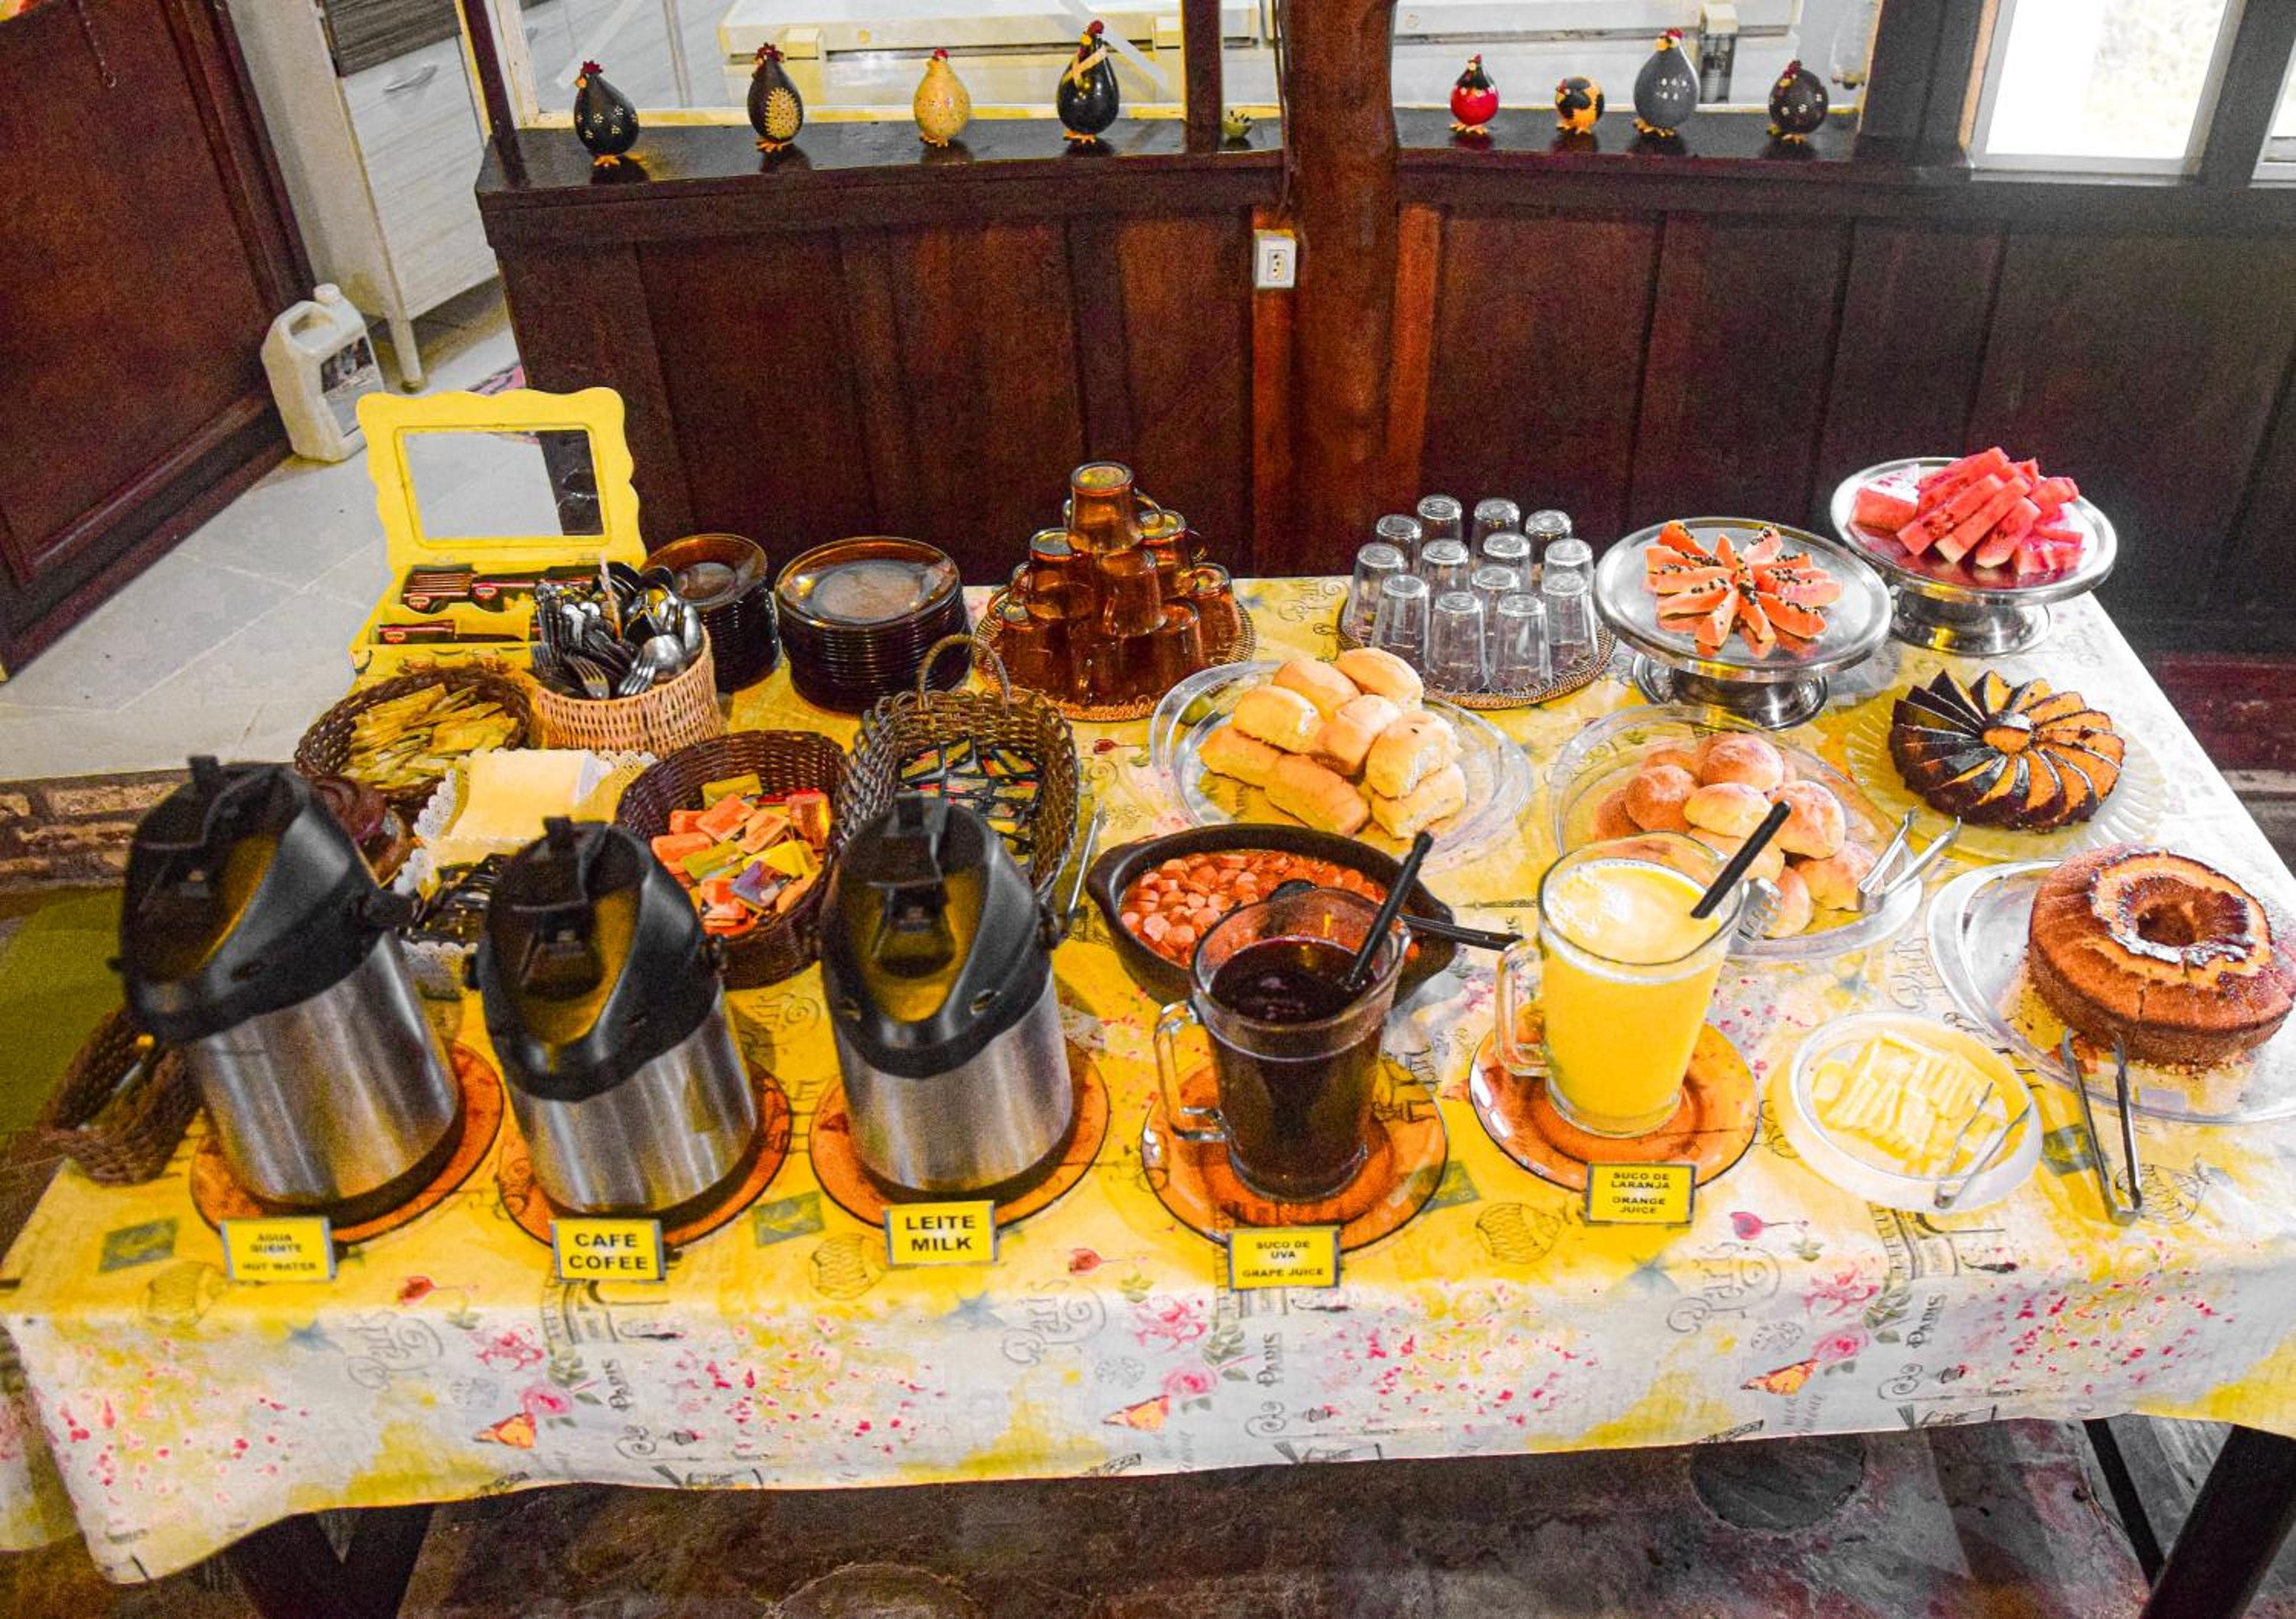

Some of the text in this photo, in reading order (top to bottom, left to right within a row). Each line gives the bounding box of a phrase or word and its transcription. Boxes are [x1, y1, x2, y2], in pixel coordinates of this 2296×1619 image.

[1613, 1171, 1670, 1181] SUCO DE
[1613, 1197, 1665, 1205] ORANGE
[1619, 1206, 1656, 1214] JUICE
[905, 1215, 976, 1230] LEITE
[912, 1237, 973, 1252] MILK
[1270, 1250, 1296, 1259] UVA
[569, 1255, 648, 1270] COFEE
[1242, 1269, 1284, 1277] GRAPE
[1254, 1332, 1283, 1388] PARIS
